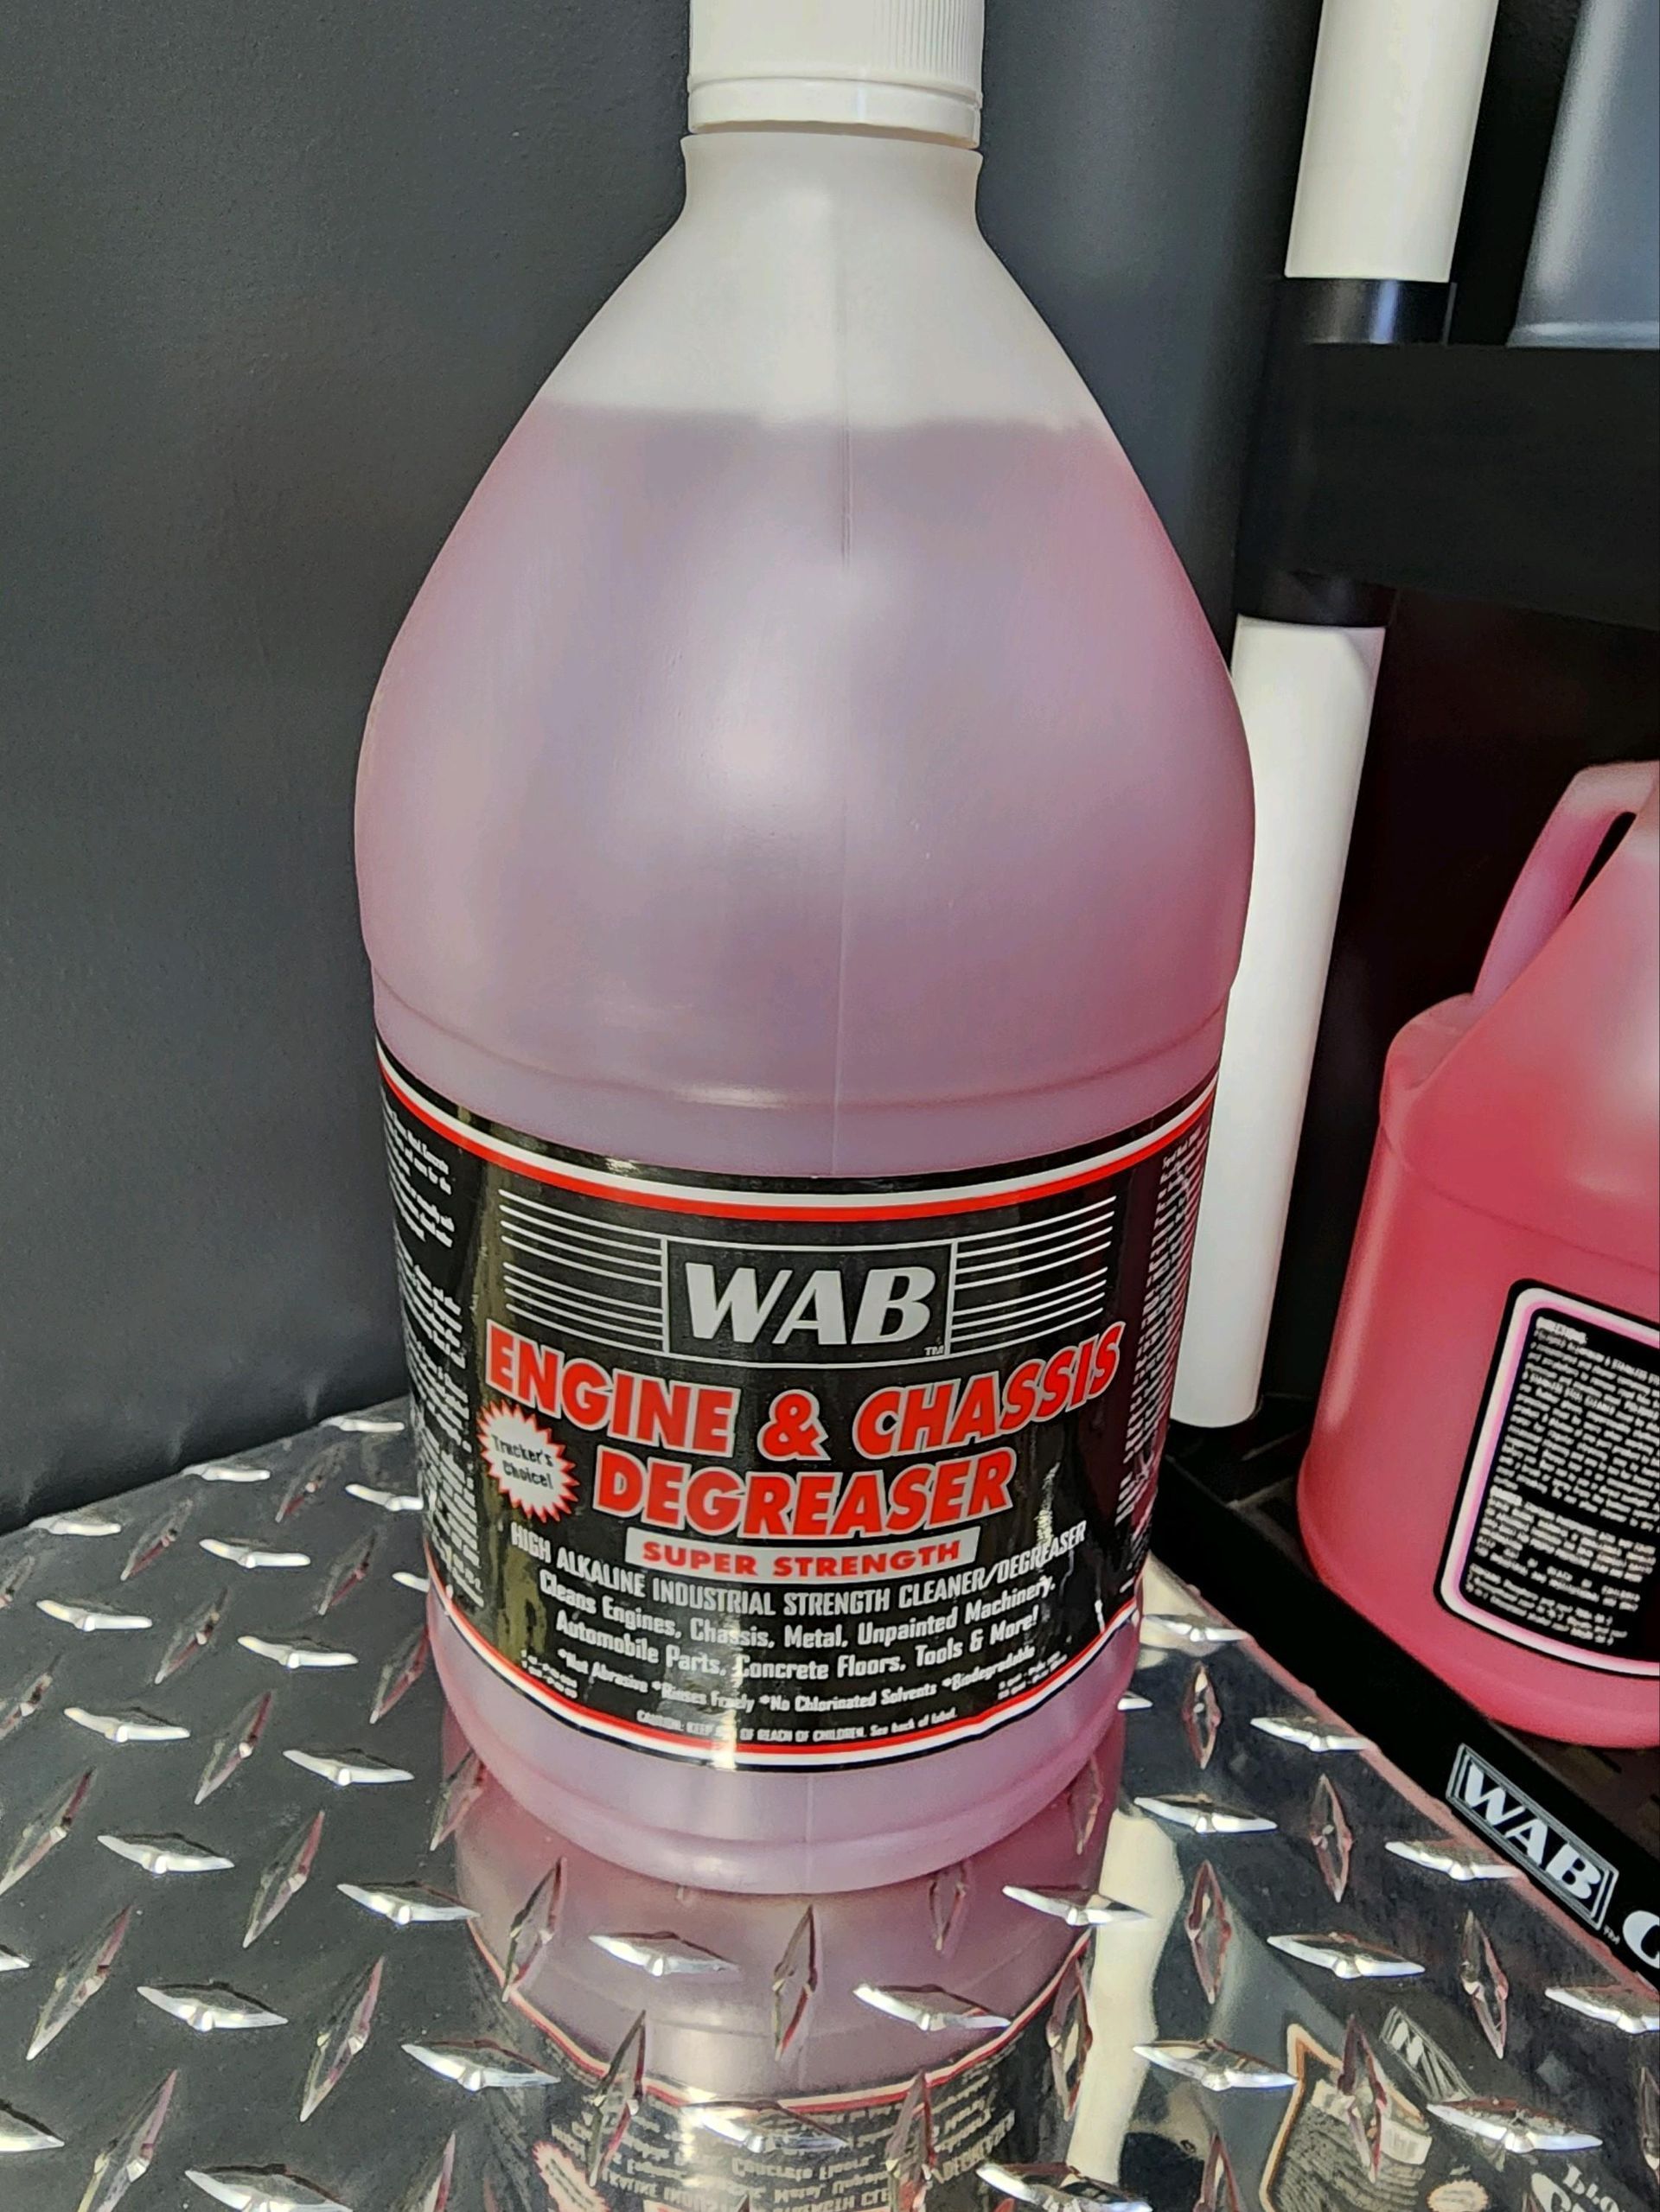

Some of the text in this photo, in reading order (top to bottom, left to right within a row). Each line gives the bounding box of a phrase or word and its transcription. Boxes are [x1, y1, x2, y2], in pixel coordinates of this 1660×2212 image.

[685, 1262, 936, 1345] WAB
[485, 1319, 1127, 1462] ENGINE & CHASSIS
[592, 1444, 1017, 1539] DEGREASER
[511, 1520, 1087, 1616] HIGH ALKALINE INDUSTRIAL STRENGTH CLEANER/DEGREASER
[642, 1540, 961, 1578] SUPER STRENGTH
[540, 1569, 597, 1614] Cleans
[858, 1607, 958, 1647] Unpainted
[556, 1610, 659, 1663] Automobile
[732, 1654, 829, 1680] Concrete
[916, 1638, 963, 1667] Tools
[969, 1629, 984, 1652] &
[990, 1604, 1039, 1645] More!
[795, 1690, 877, 1712] Chlorinated
[880, 1683, 937, 1705] Solvents
[1465, 1763, 1601, 1900] WAB
